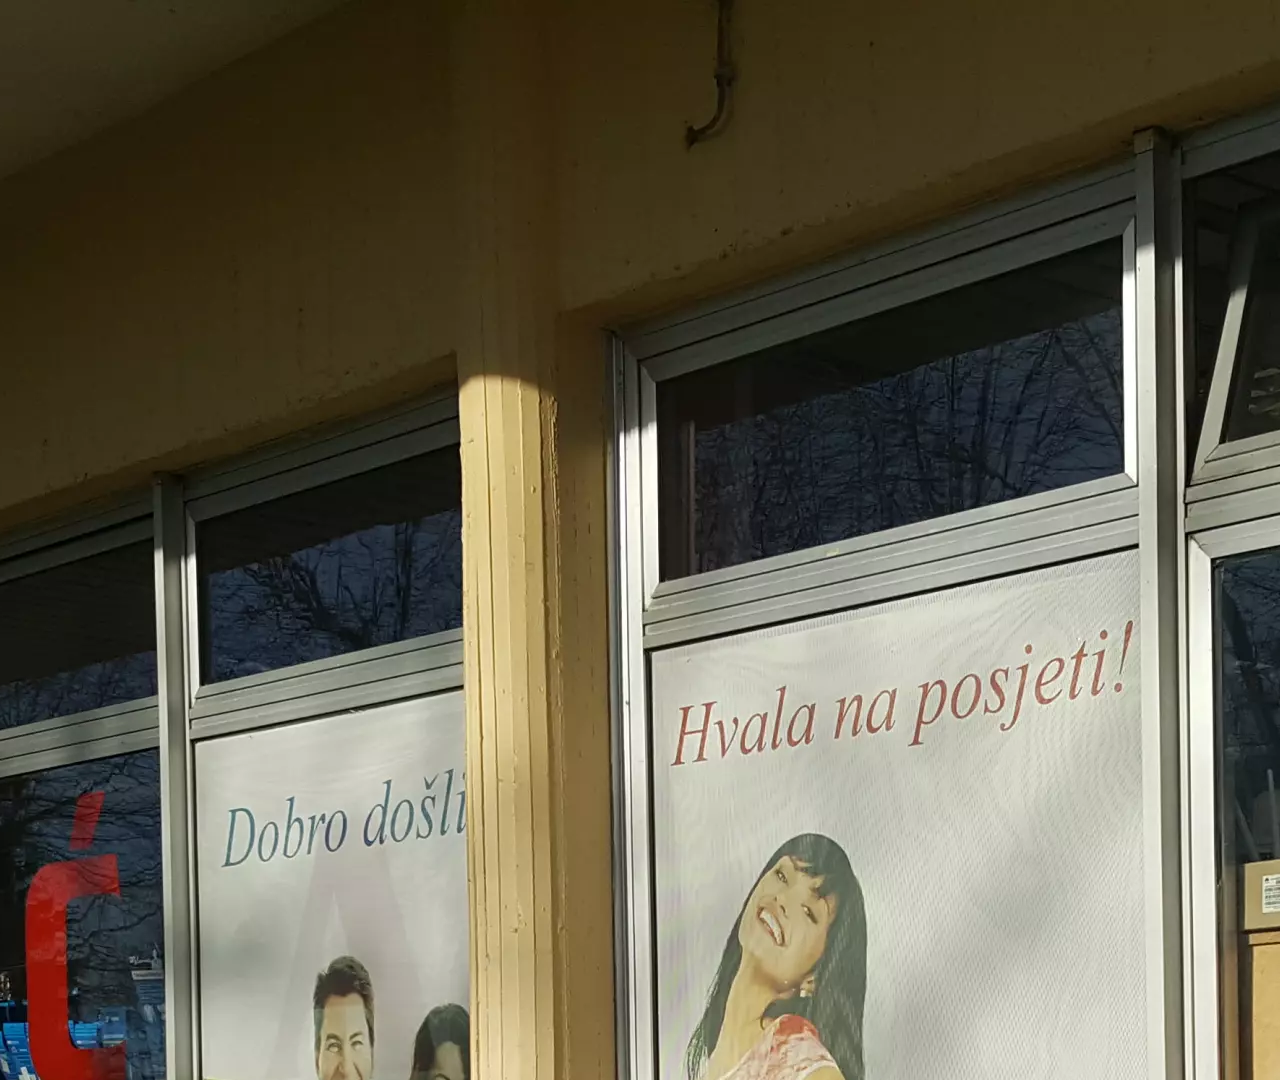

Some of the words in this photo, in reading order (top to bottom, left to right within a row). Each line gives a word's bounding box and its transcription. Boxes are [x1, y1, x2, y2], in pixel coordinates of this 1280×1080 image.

[670, 685, 817, 767] Hvala
[833, 687, 898, 740] na
[907, 619, 1134, 747] posjeti!
[220, 796, 348, 868] Dobro
[362, 768, 467, 848] došli
